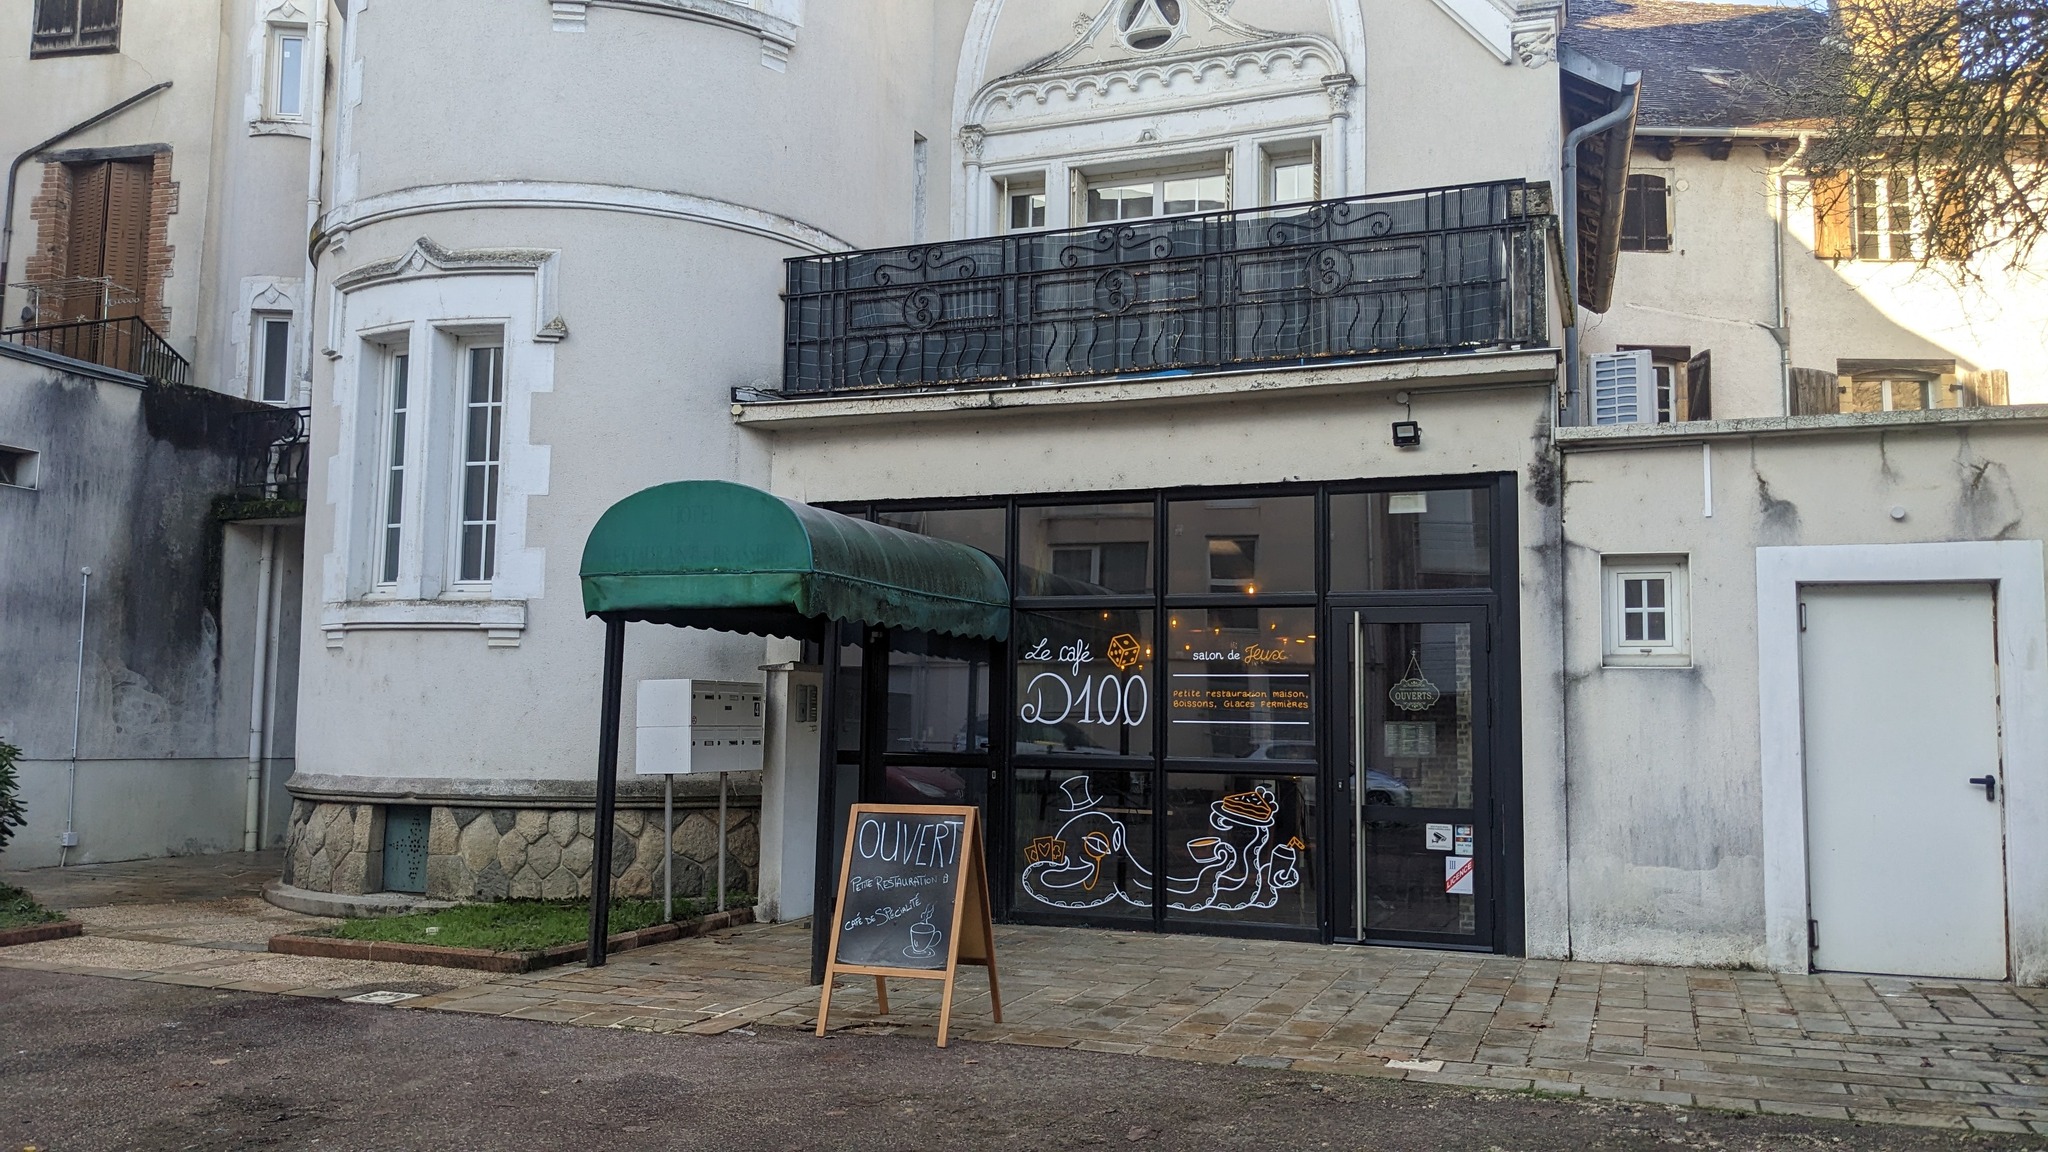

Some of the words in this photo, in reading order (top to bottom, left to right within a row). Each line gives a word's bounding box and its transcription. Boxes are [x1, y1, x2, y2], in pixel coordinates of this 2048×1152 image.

[1025, 637, 1053, 661] Le
[1057, 638, 1095, 677] café
[1192, 649, 1224, 661] salon
[1227, 649, 1241, 661] de
[1244, 643, 1288, 664] Jeux
[1020, 672, 1148, 727] D100
[1272, 689, 1309, 699] maison,
[859, 820, 963, 868] OUVERT
[875, 873, 937, 891] RESTAURATION
[1446, 861, 1473, 889] LICENCE
[865, 915, 876, 925] DE
